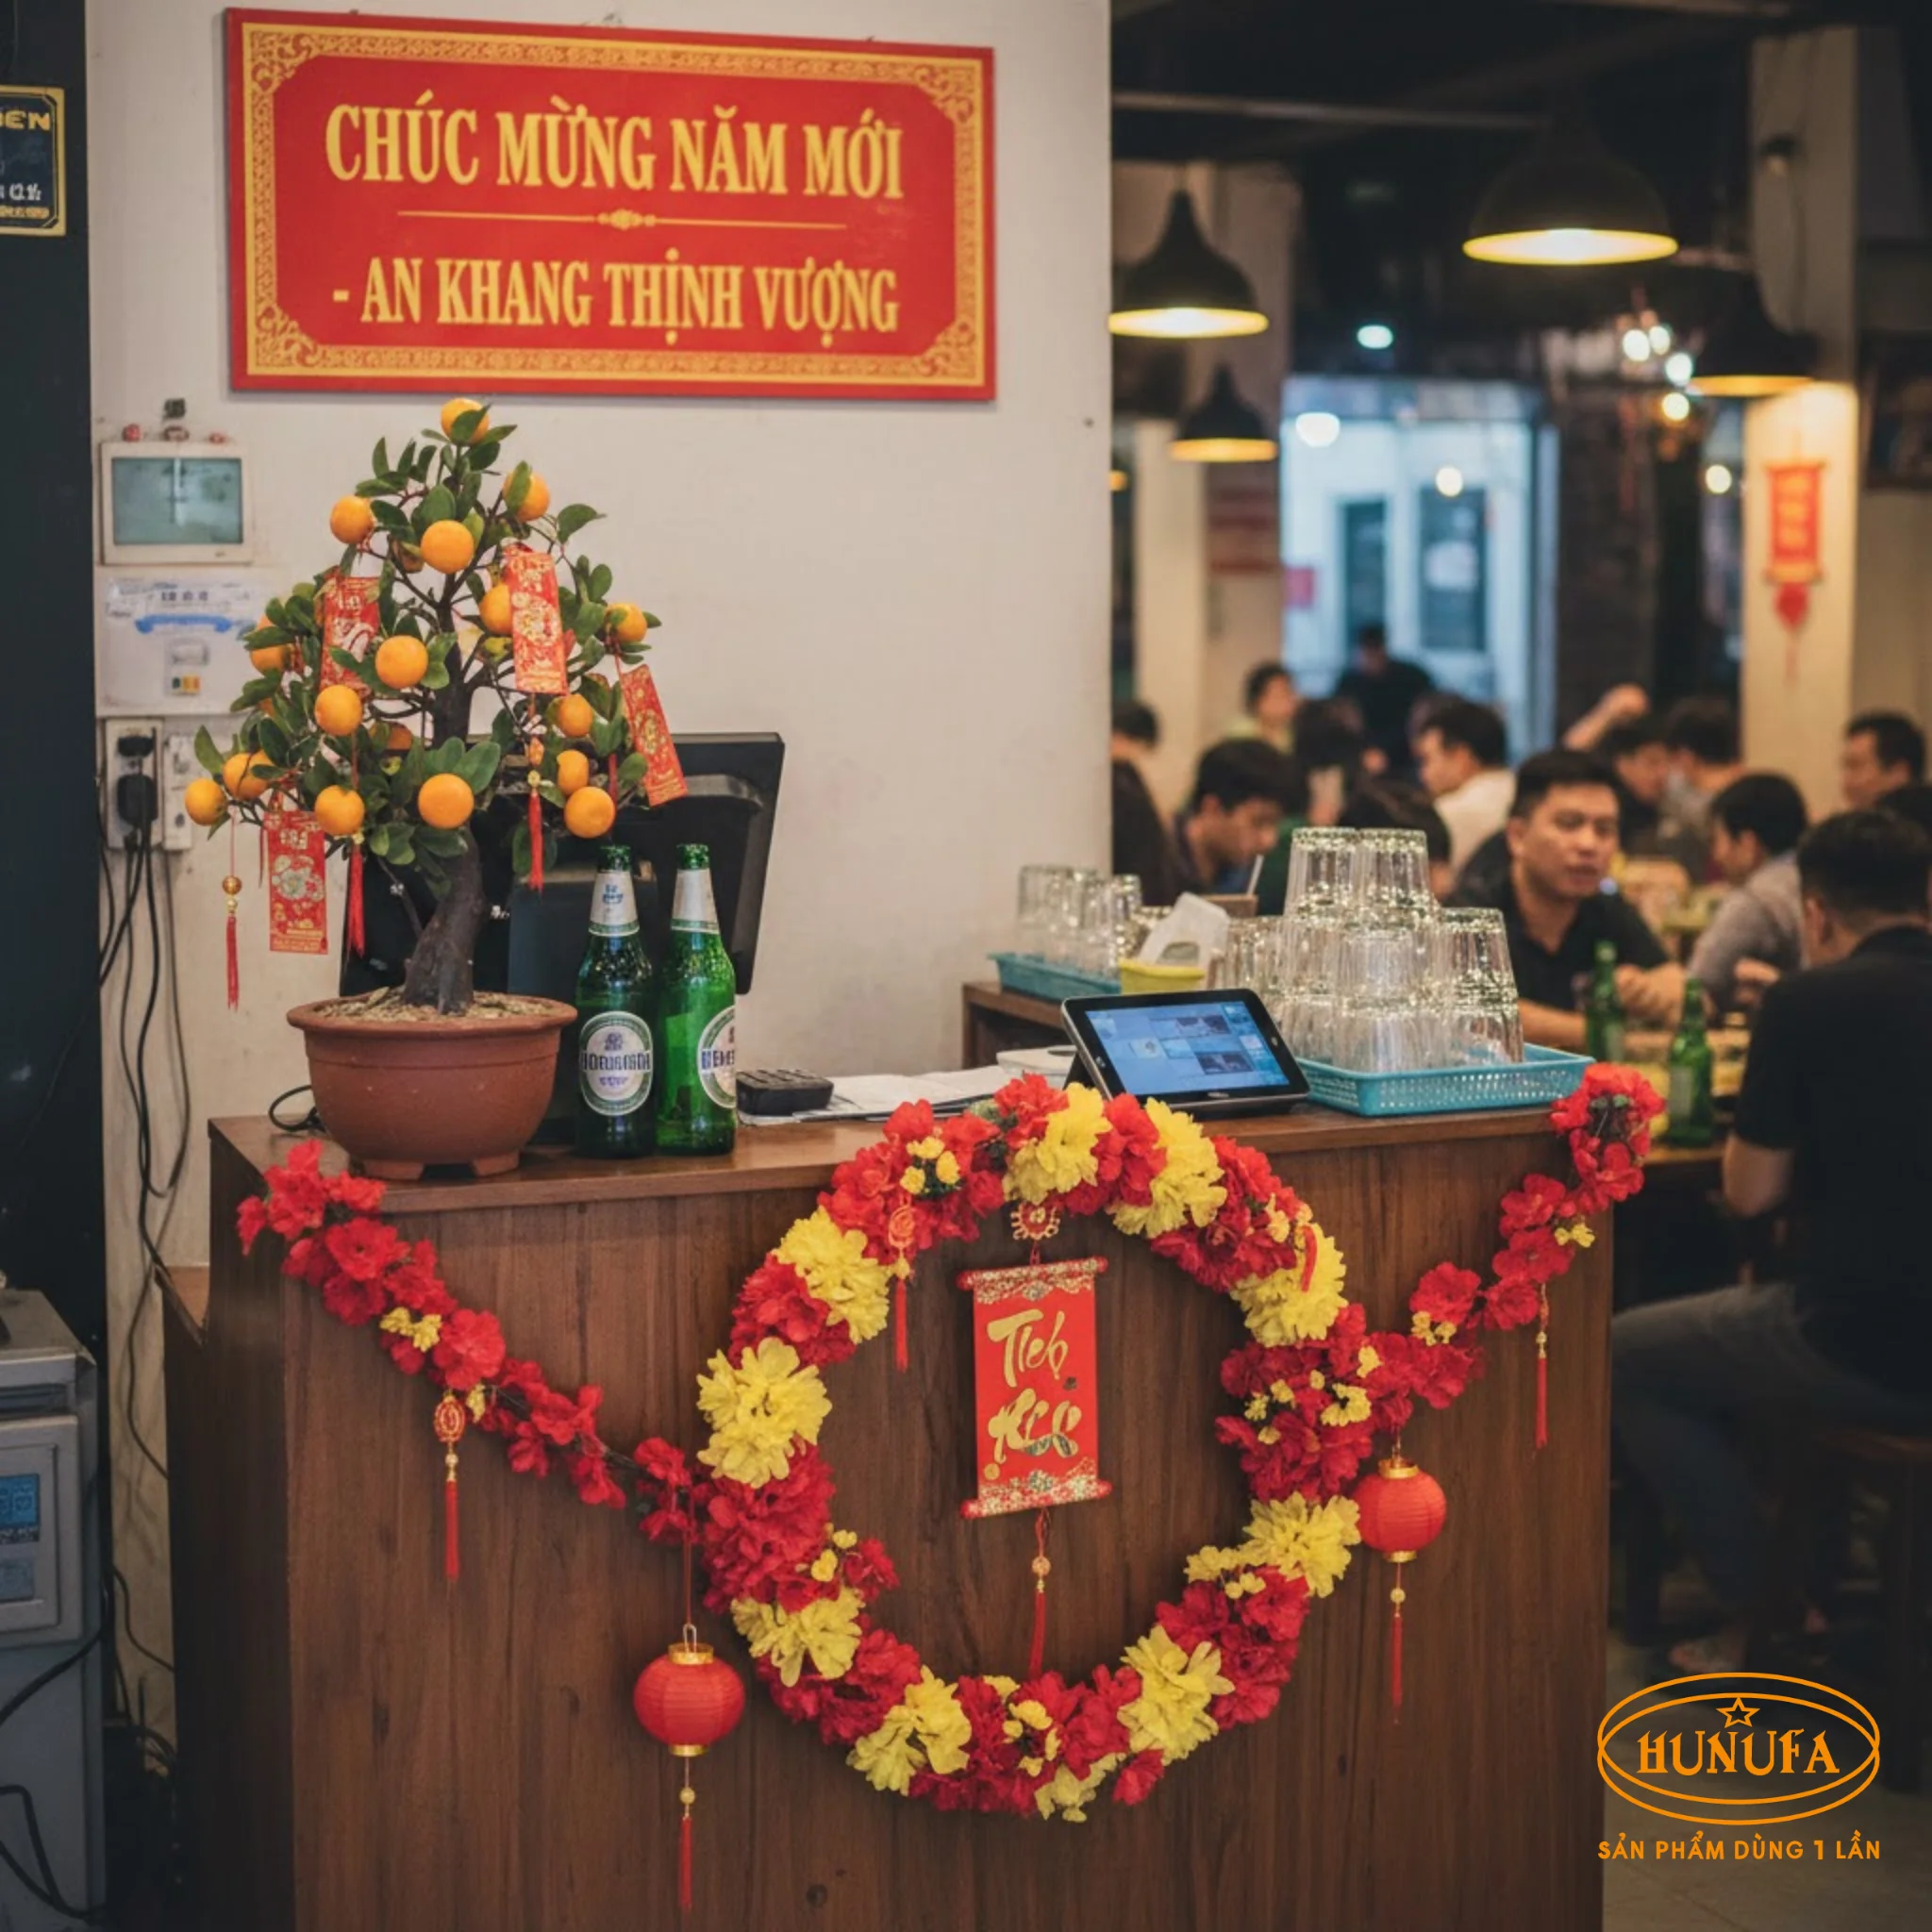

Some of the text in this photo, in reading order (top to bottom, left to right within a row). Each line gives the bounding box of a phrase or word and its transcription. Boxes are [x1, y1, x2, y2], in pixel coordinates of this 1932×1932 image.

[325, 90, 904, 200] CHÚC MỪNG NĂM MỚI
[360, 258, 424, 324] AN
[435, 258, 593, 329] KHANG
[603, 246, 744, 346] THỊNH
[753, 256, 900, 348] VƯỢNG
